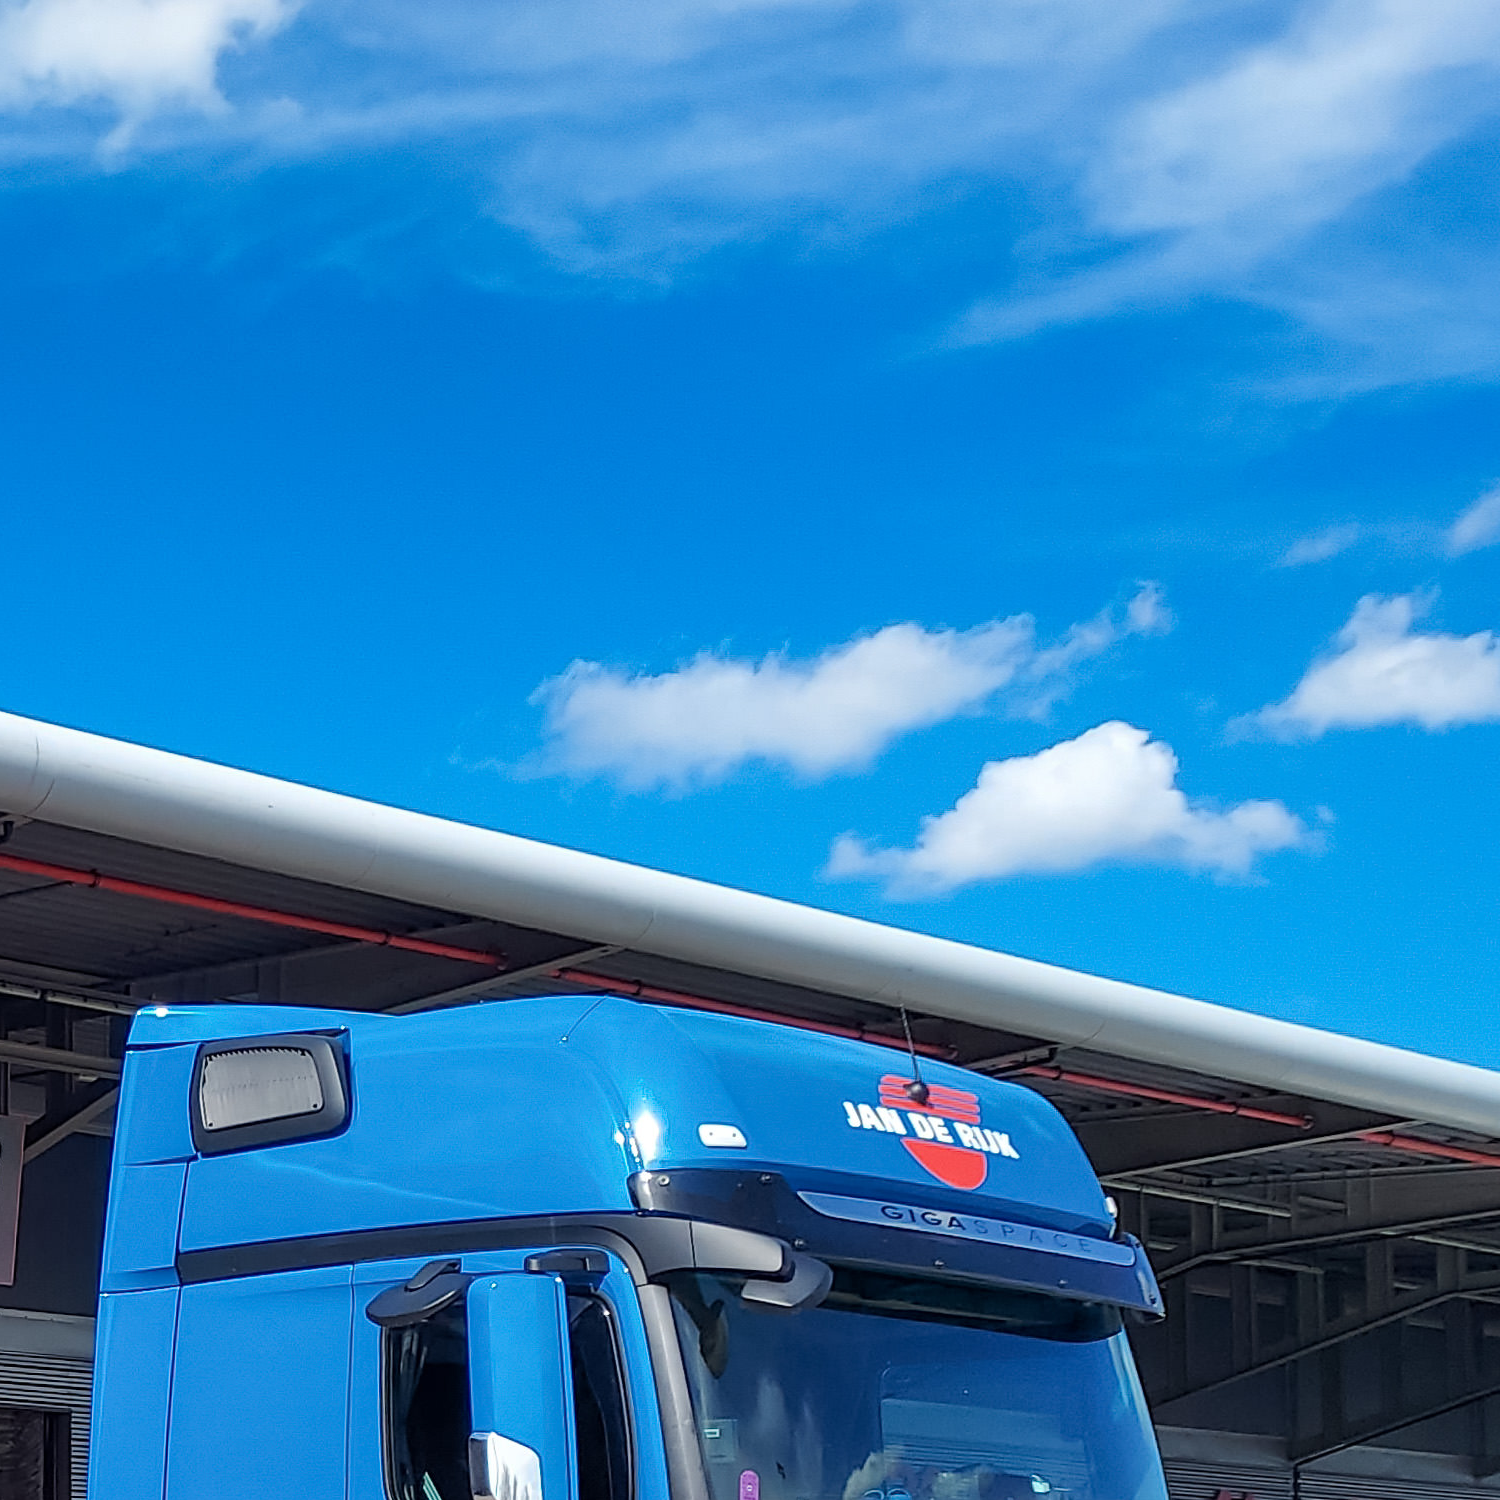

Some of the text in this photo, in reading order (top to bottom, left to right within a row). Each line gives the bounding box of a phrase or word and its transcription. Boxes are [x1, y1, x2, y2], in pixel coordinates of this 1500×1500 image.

[842, 1100, 1020, 1160] JAN DE RIJK
[880, 1204, 1093, 1254] GIGASPACE
